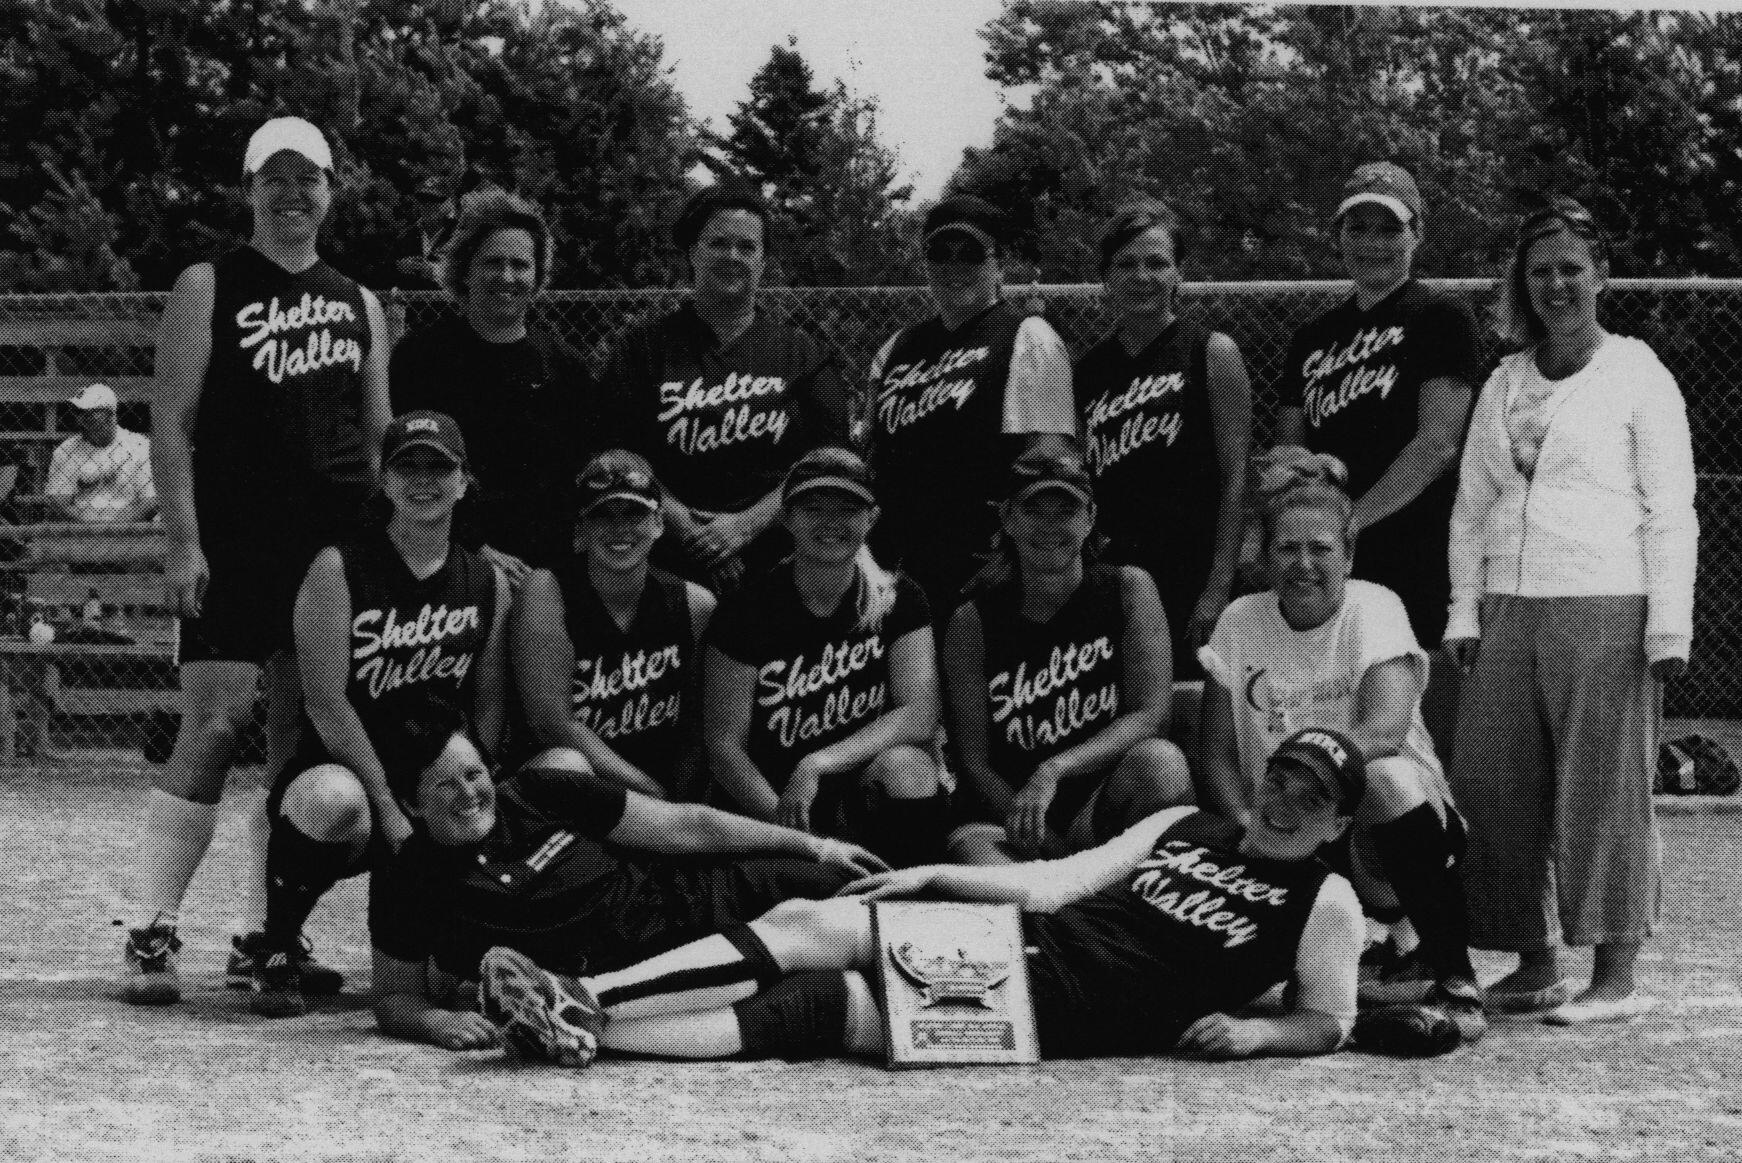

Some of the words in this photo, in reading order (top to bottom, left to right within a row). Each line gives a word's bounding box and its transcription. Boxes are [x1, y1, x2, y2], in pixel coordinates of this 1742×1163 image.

[236, 292, 356, 349] Shelter
[252, 328, 361, 384] Valley
[877, 345, 989, 402] Shelter
[1303, 326, 1405, 398] Shelter
[657, 371, 786, 422] Shelter
[878, 378, 977, 435] Valley
[1303, 364, 1399, 428] Valley
[667, 403, 789, 456] Valley
[1086, 411, 1183, 478] Valley
[352, 603, 479, 660] Shelter
[356, 645, 474, 700] Valley
[757, 634, 885, 707] Shelter
[988, 636, 1114, 722] Shelter
[767, 681, 886, 748] Valley
[1006, 682, 1119, 751] Valley
[1136, 840, 1289, 906] Shelter
[1131, 869, 1258, 948] Valley
